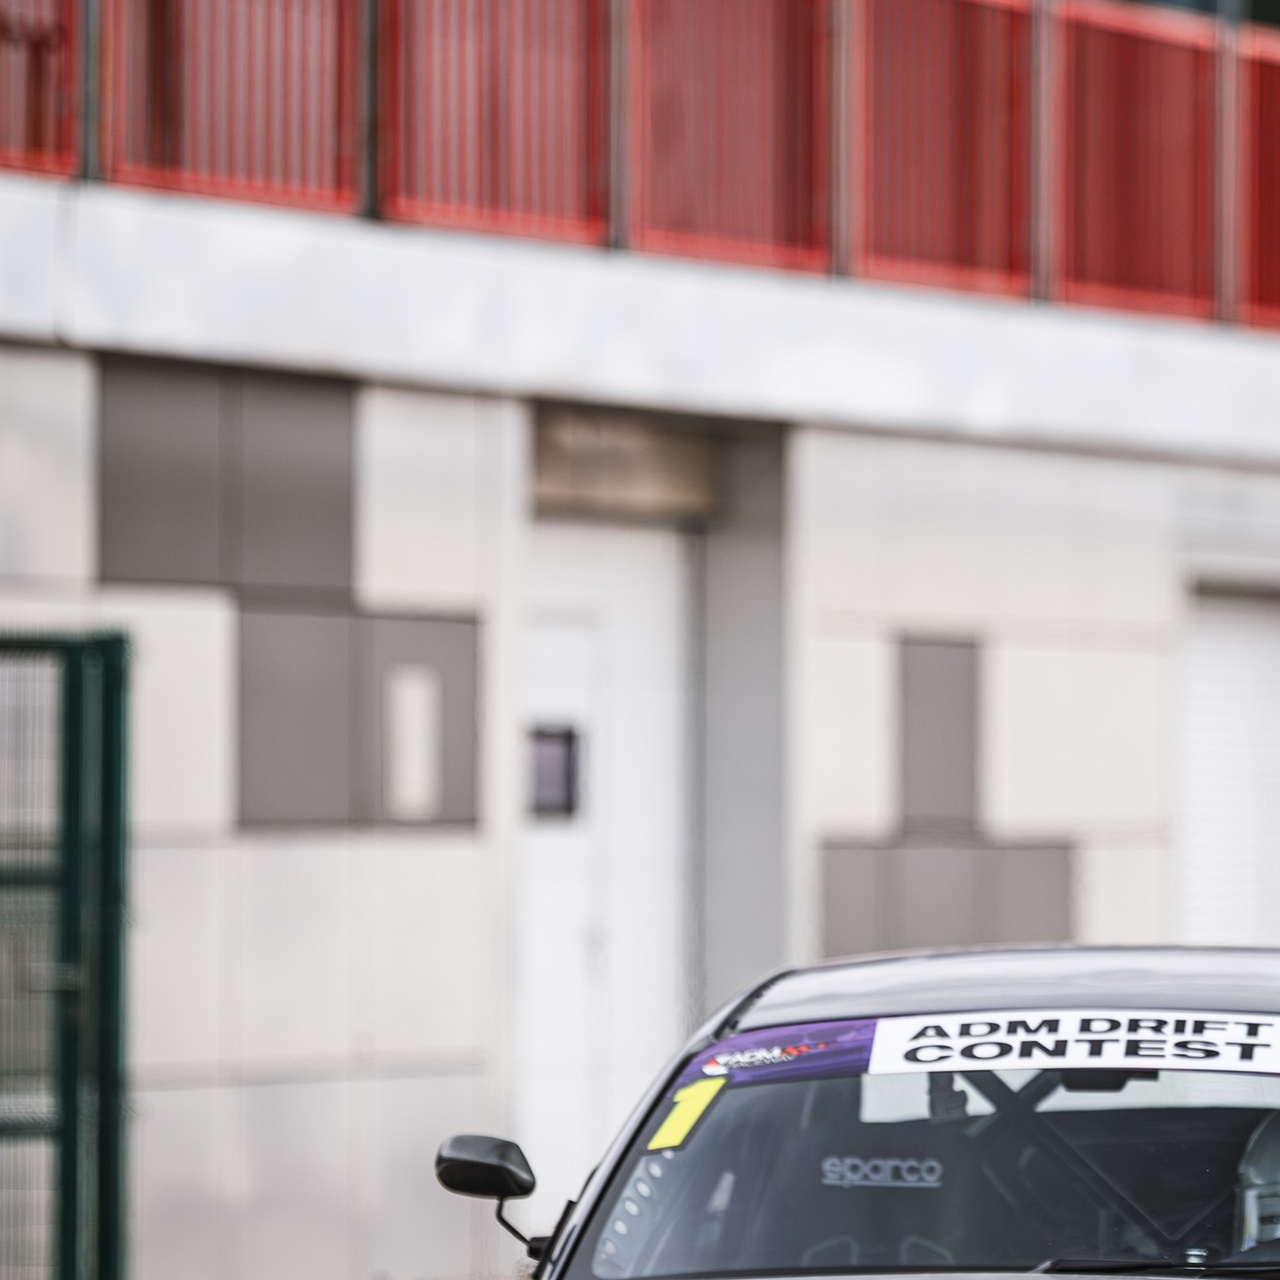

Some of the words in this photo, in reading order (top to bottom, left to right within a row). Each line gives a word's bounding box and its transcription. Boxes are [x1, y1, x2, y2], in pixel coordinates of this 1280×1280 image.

[910, 1018, 1060, 1041] ADM
[1077, 1017, 1274, 1038] DRIFT
[903, 1038, 1272, 1064] CONTEST
[647, 1077, 727, 1150] 1
[822, 1157, 942, 1188] sparco
